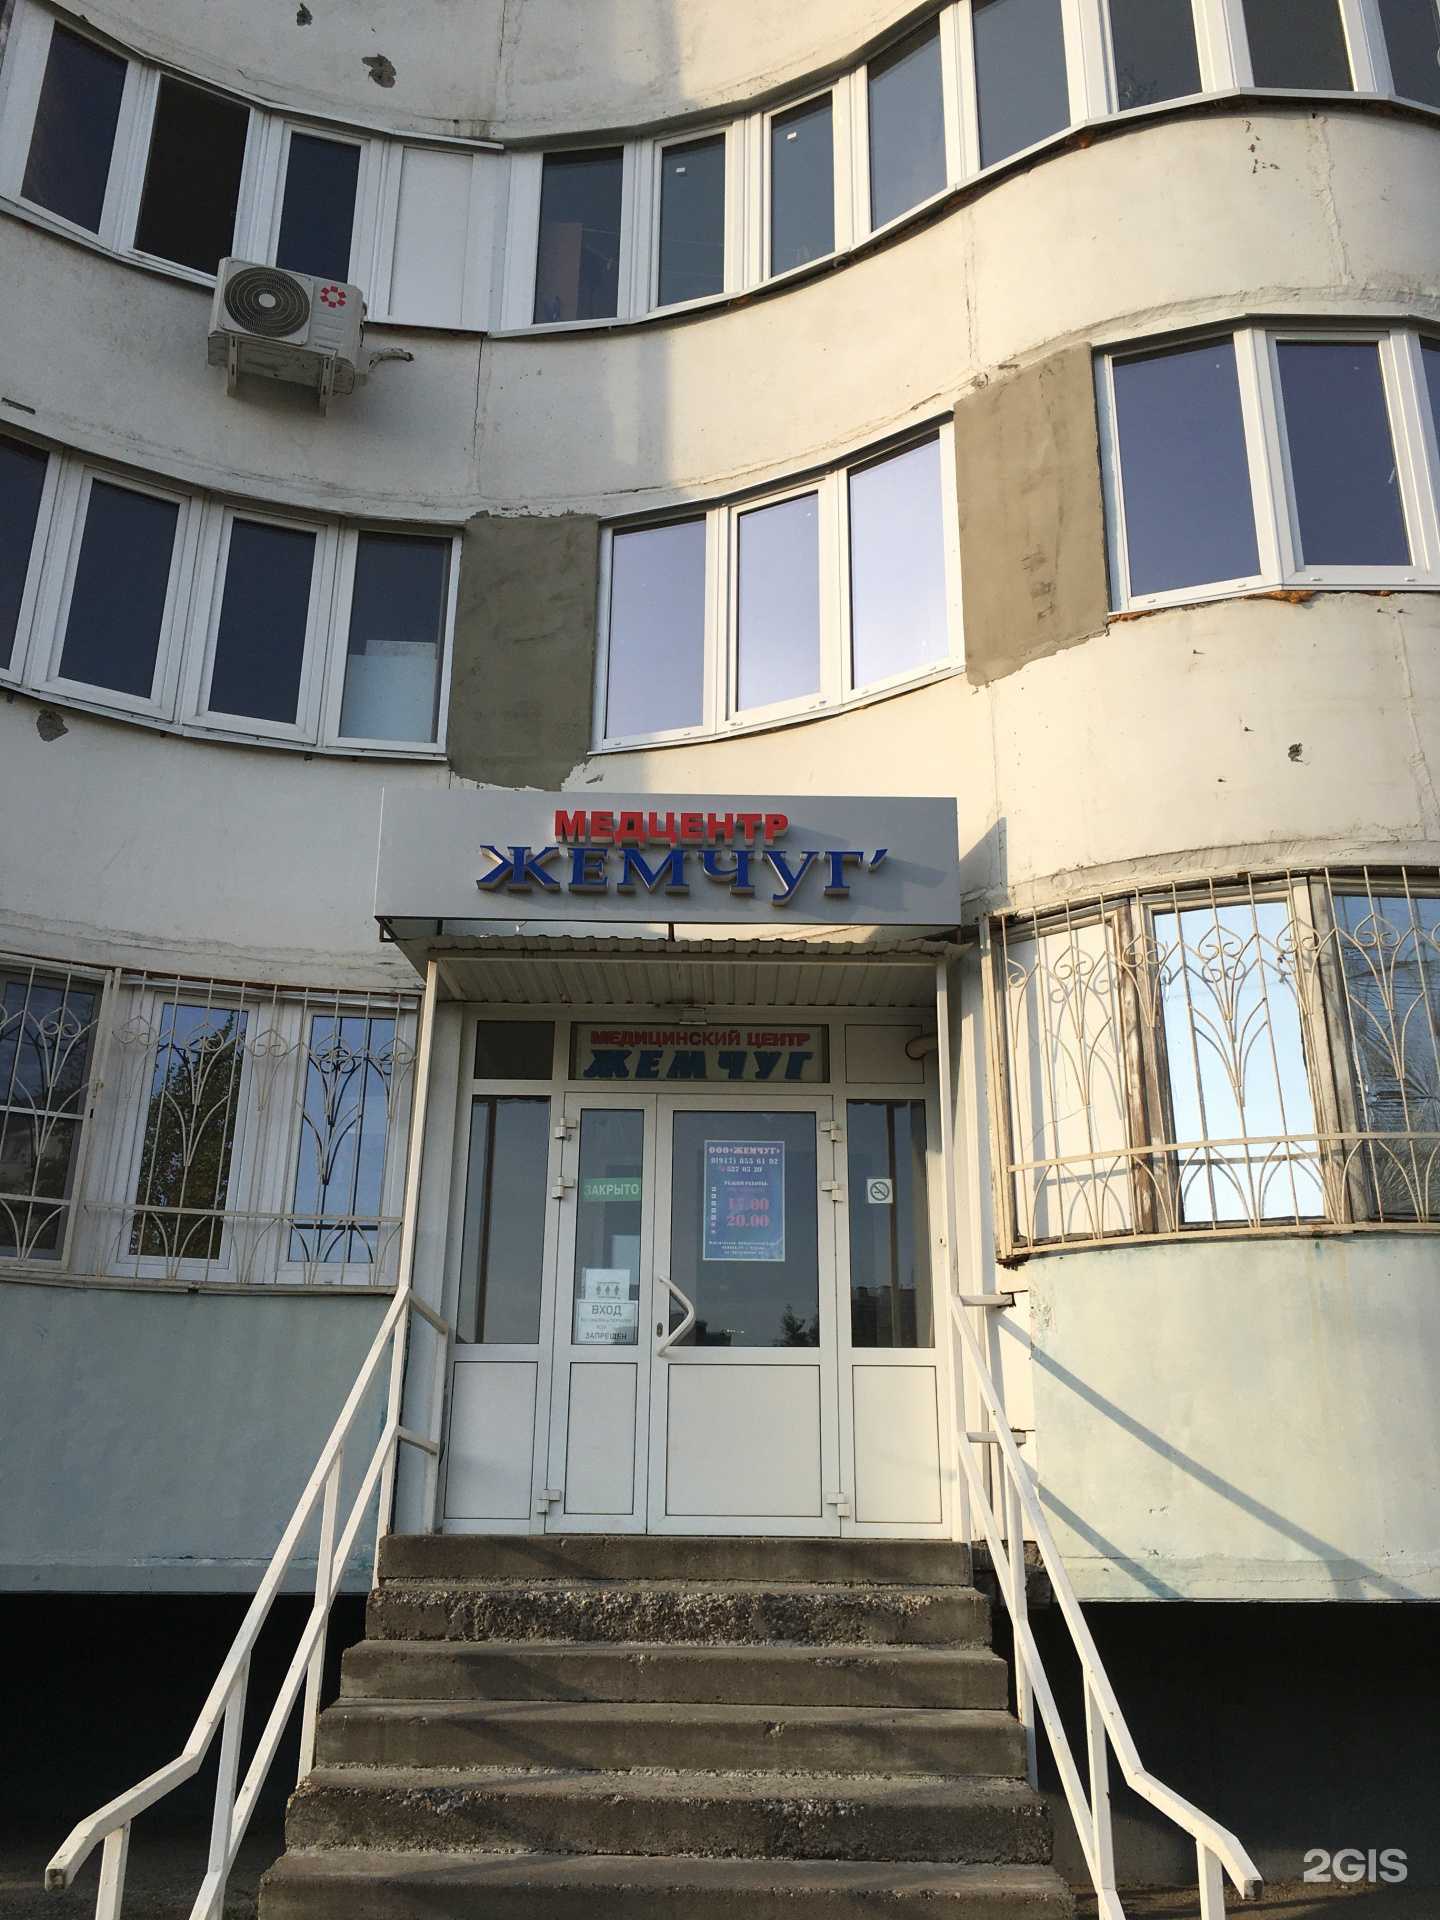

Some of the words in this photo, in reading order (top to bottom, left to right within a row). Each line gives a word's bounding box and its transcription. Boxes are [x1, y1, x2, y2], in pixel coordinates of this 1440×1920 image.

[555, 810, 789, 847] МЕДЦЕНТР
[591, 1030, 741, 1047] МЕДИЦИНСКИЙ
[747, 1032, 811, 1048] ЦЕНТР
[583, 1050, 814, 1081] ЖЕМЧУГ
[583, 1183, 640, 1196] ЗАКРЫТО
[591, 1304, 622, 1317] ВХОД
